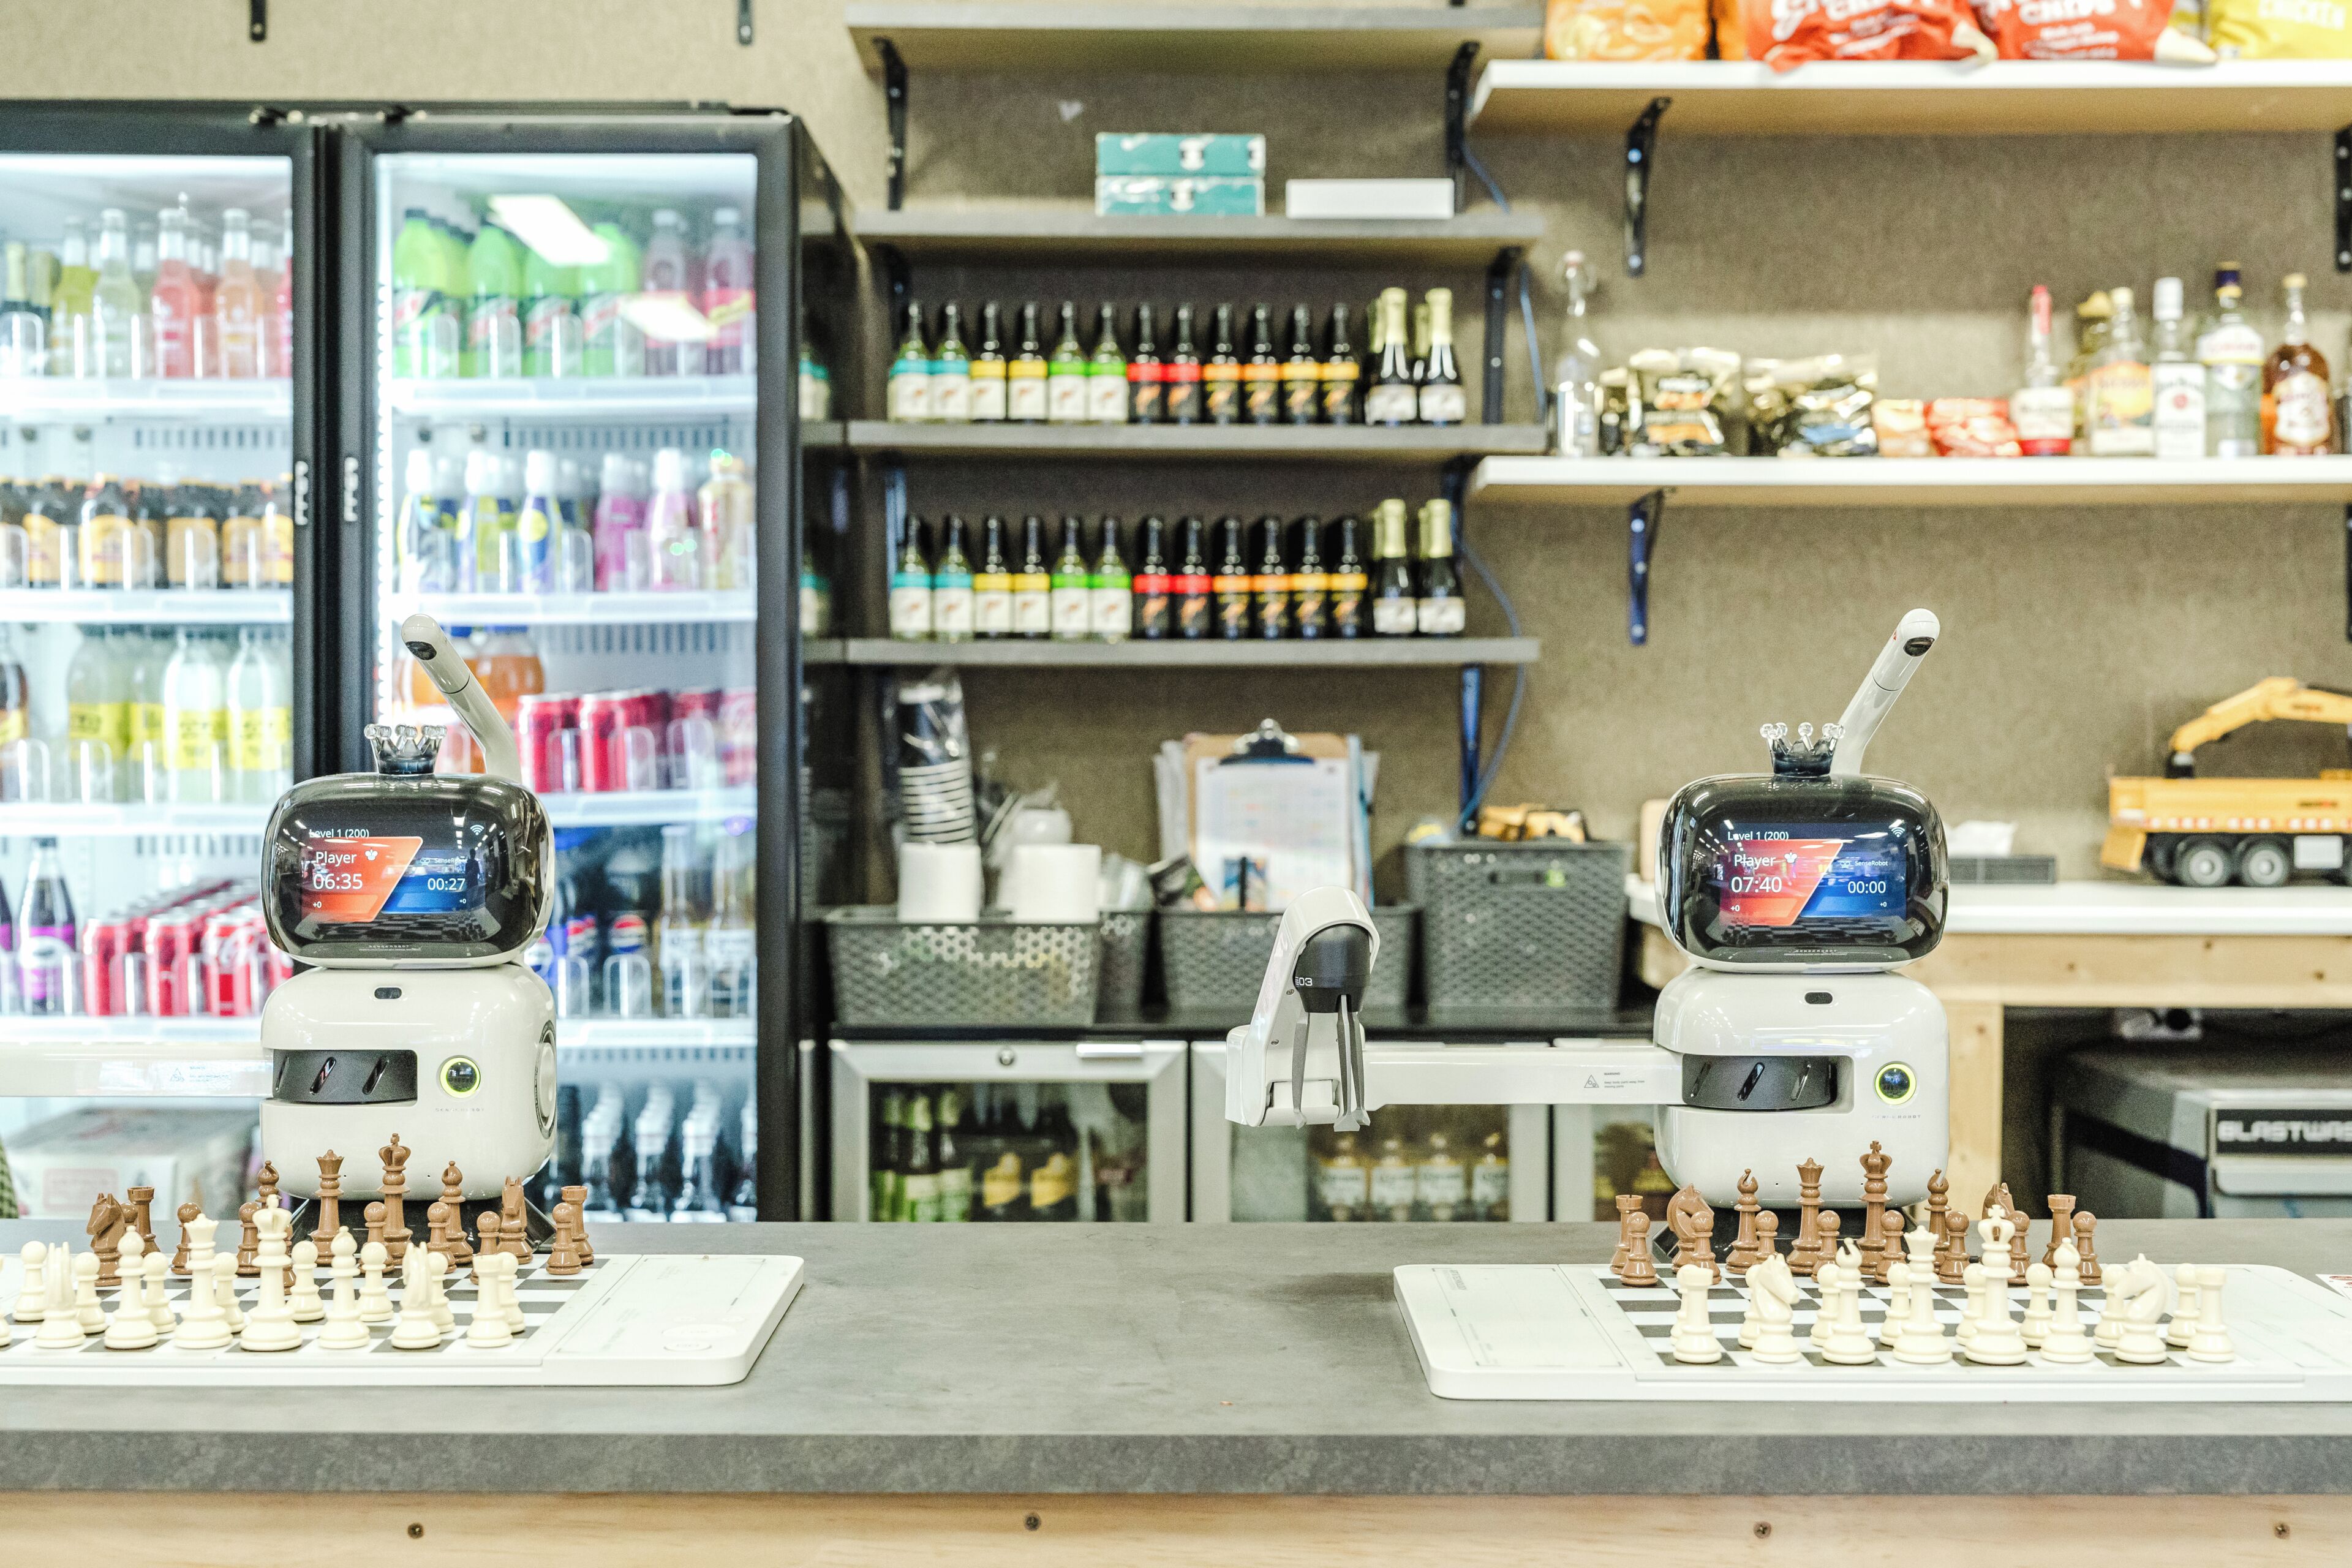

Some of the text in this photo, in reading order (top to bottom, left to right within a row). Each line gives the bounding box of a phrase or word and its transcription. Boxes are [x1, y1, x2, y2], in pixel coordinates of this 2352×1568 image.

[309, 829, 369, 839] Level 1 (200)
[1727, 831, 1789, 842] Lvel 1 (200)
[315, 851, 357, 867] Player
[1734, 854, 1776, 870] Player
[313, 873, 363, 889] 06:35
[428, 878, 466, 891] 00:27
[1731, 876, 1782, 893] 07:40
[1847, 881, 1887, 894] 00:00
[1298, 977, 1313, 986] 03
